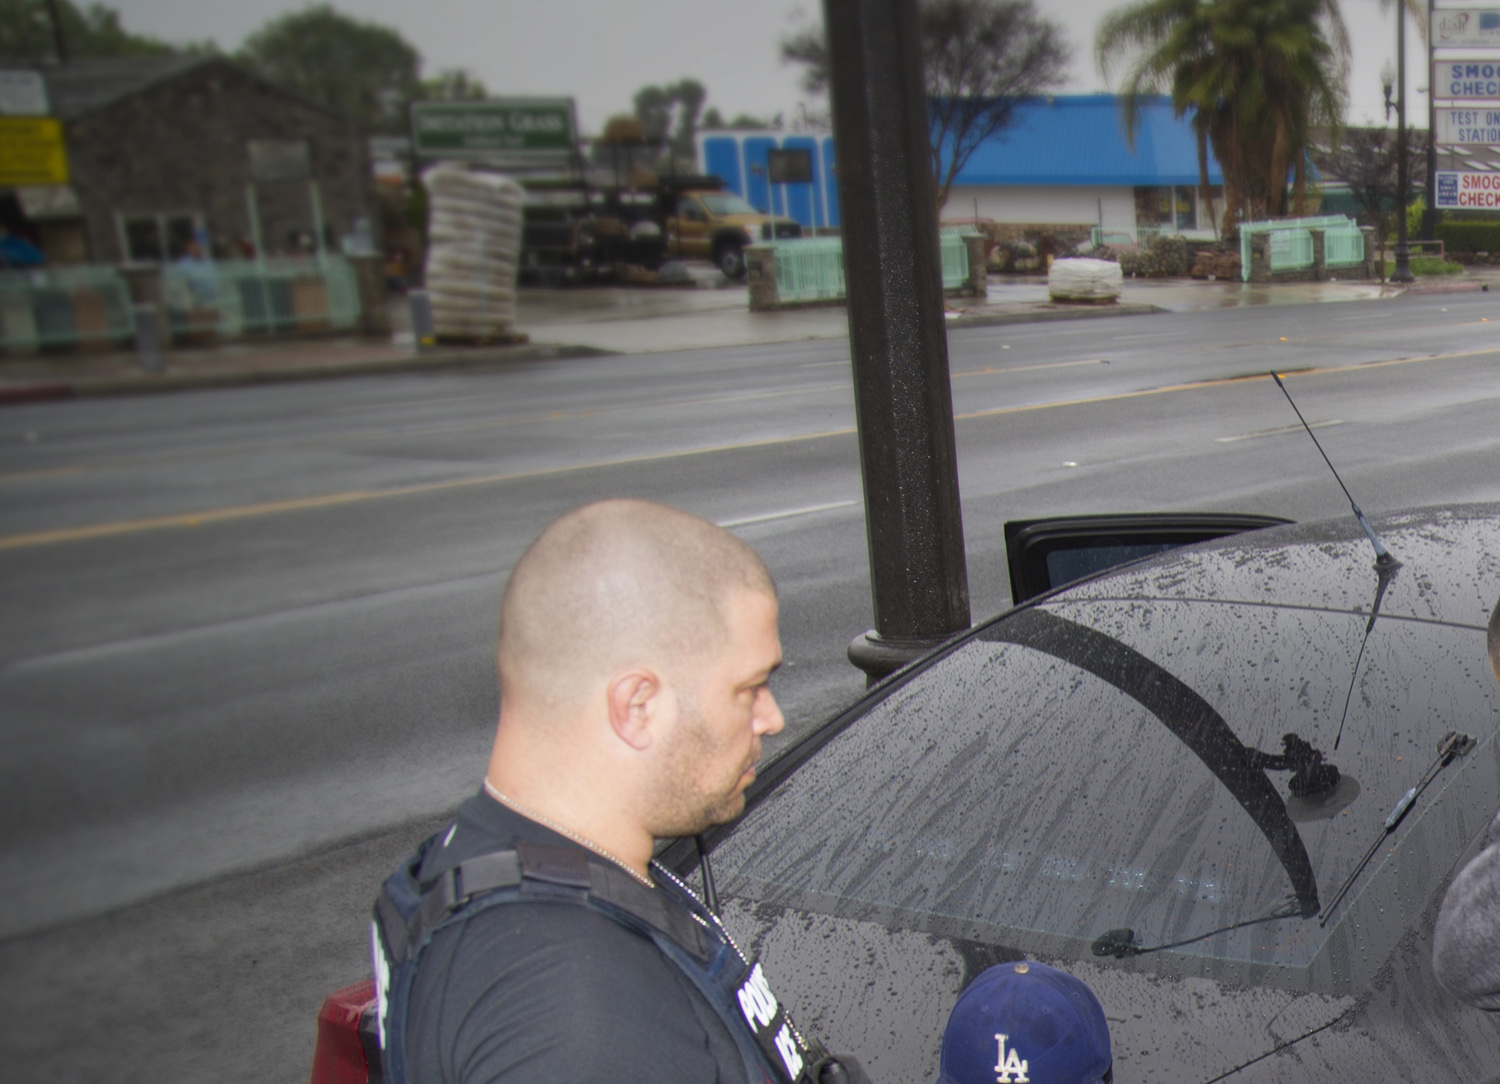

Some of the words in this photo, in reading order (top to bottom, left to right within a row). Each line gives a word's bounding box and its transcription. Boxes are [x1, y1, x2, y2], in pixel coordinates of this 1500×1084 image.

[1450, 111, 1479, 126] TEST
[1462, 174, 1500, 190] SMOG
[774, 1023, 803, 1081] ICE
[993, 1033, 1030, 1084] LA
